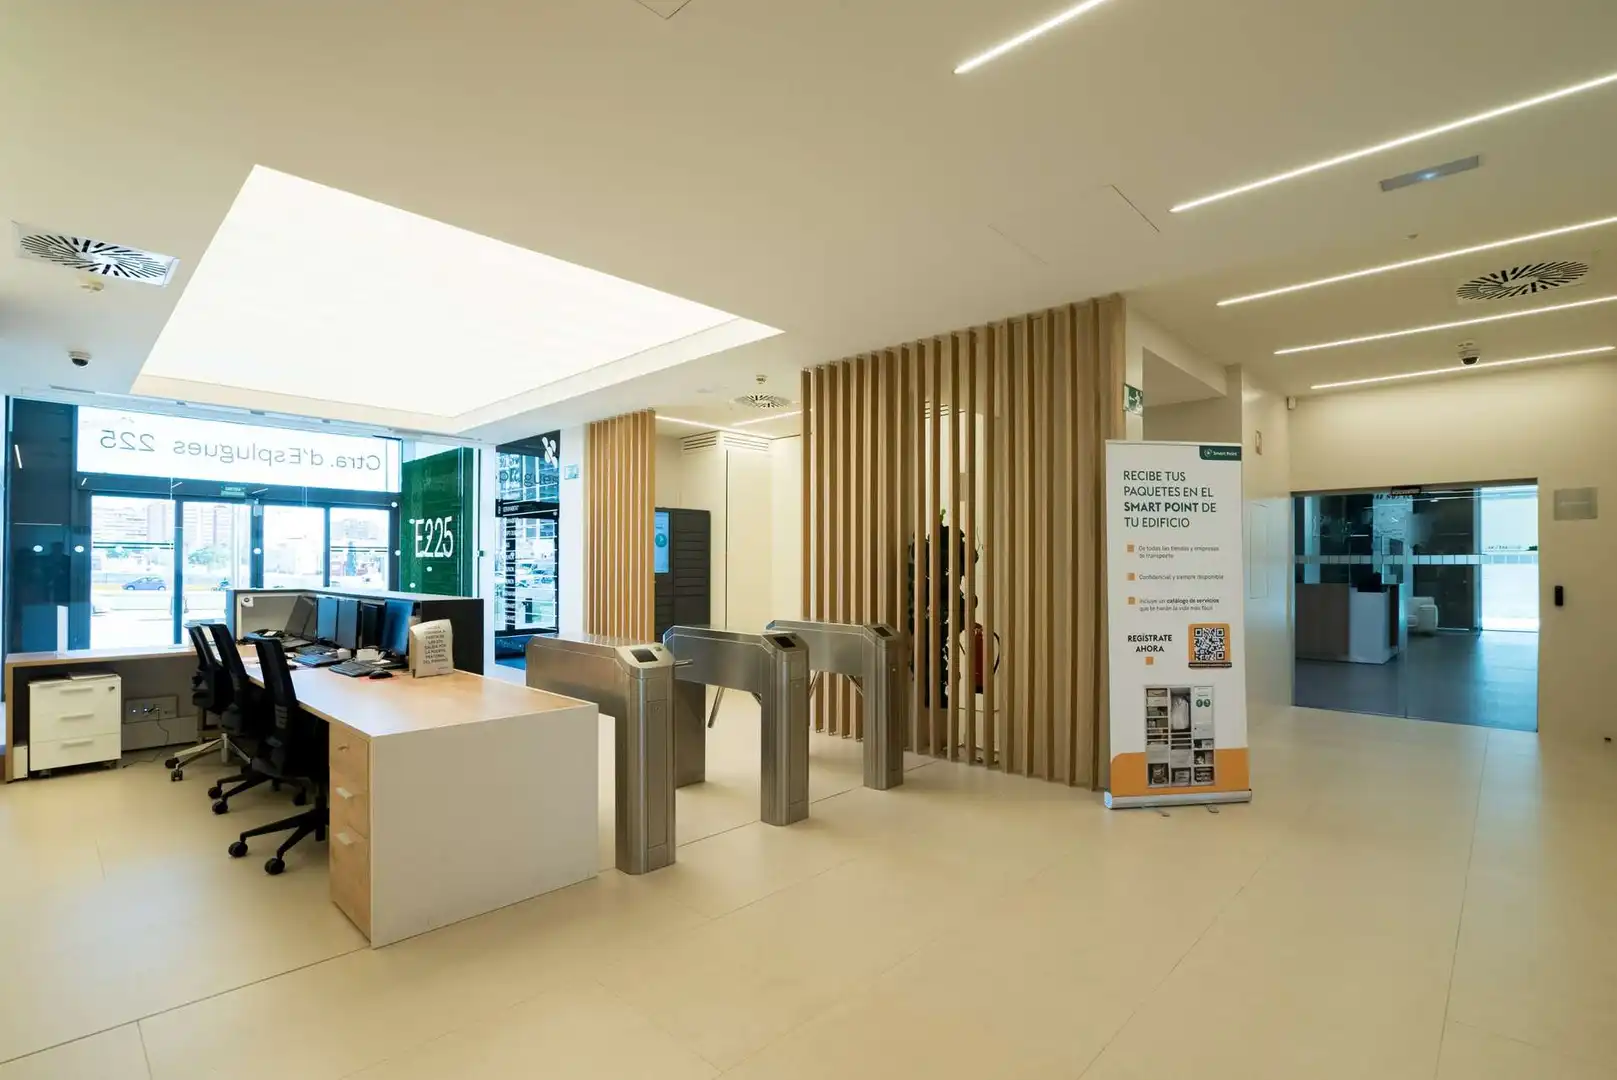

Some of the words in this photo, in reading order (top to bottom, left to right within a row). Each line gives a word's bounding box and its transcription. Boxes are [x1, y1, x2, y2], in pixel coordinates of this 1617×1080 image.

[1123, 470, 1162, 481] RECIBE
[1165, 471, 1186, 482] TUS
[1123, 486, 1181, 497] PAQUETES
[1183, 487, 1198, 497] EN
[1201, 487, 1214, 498] EL
[1124, 502, 1162, 512] SMART
[1164, 502, 1199, 512] POINT
[1202, 502, 1217, 513] DE
[1124, 517, 1139, 527] TU
[1142, 517, 1190, 528] EDIFICIO
[415, 515, 454, 558] E225
[1166, 597, 1189, 605] catálogo
[1127, 633, 1173, 642] REGÍSTRATE
